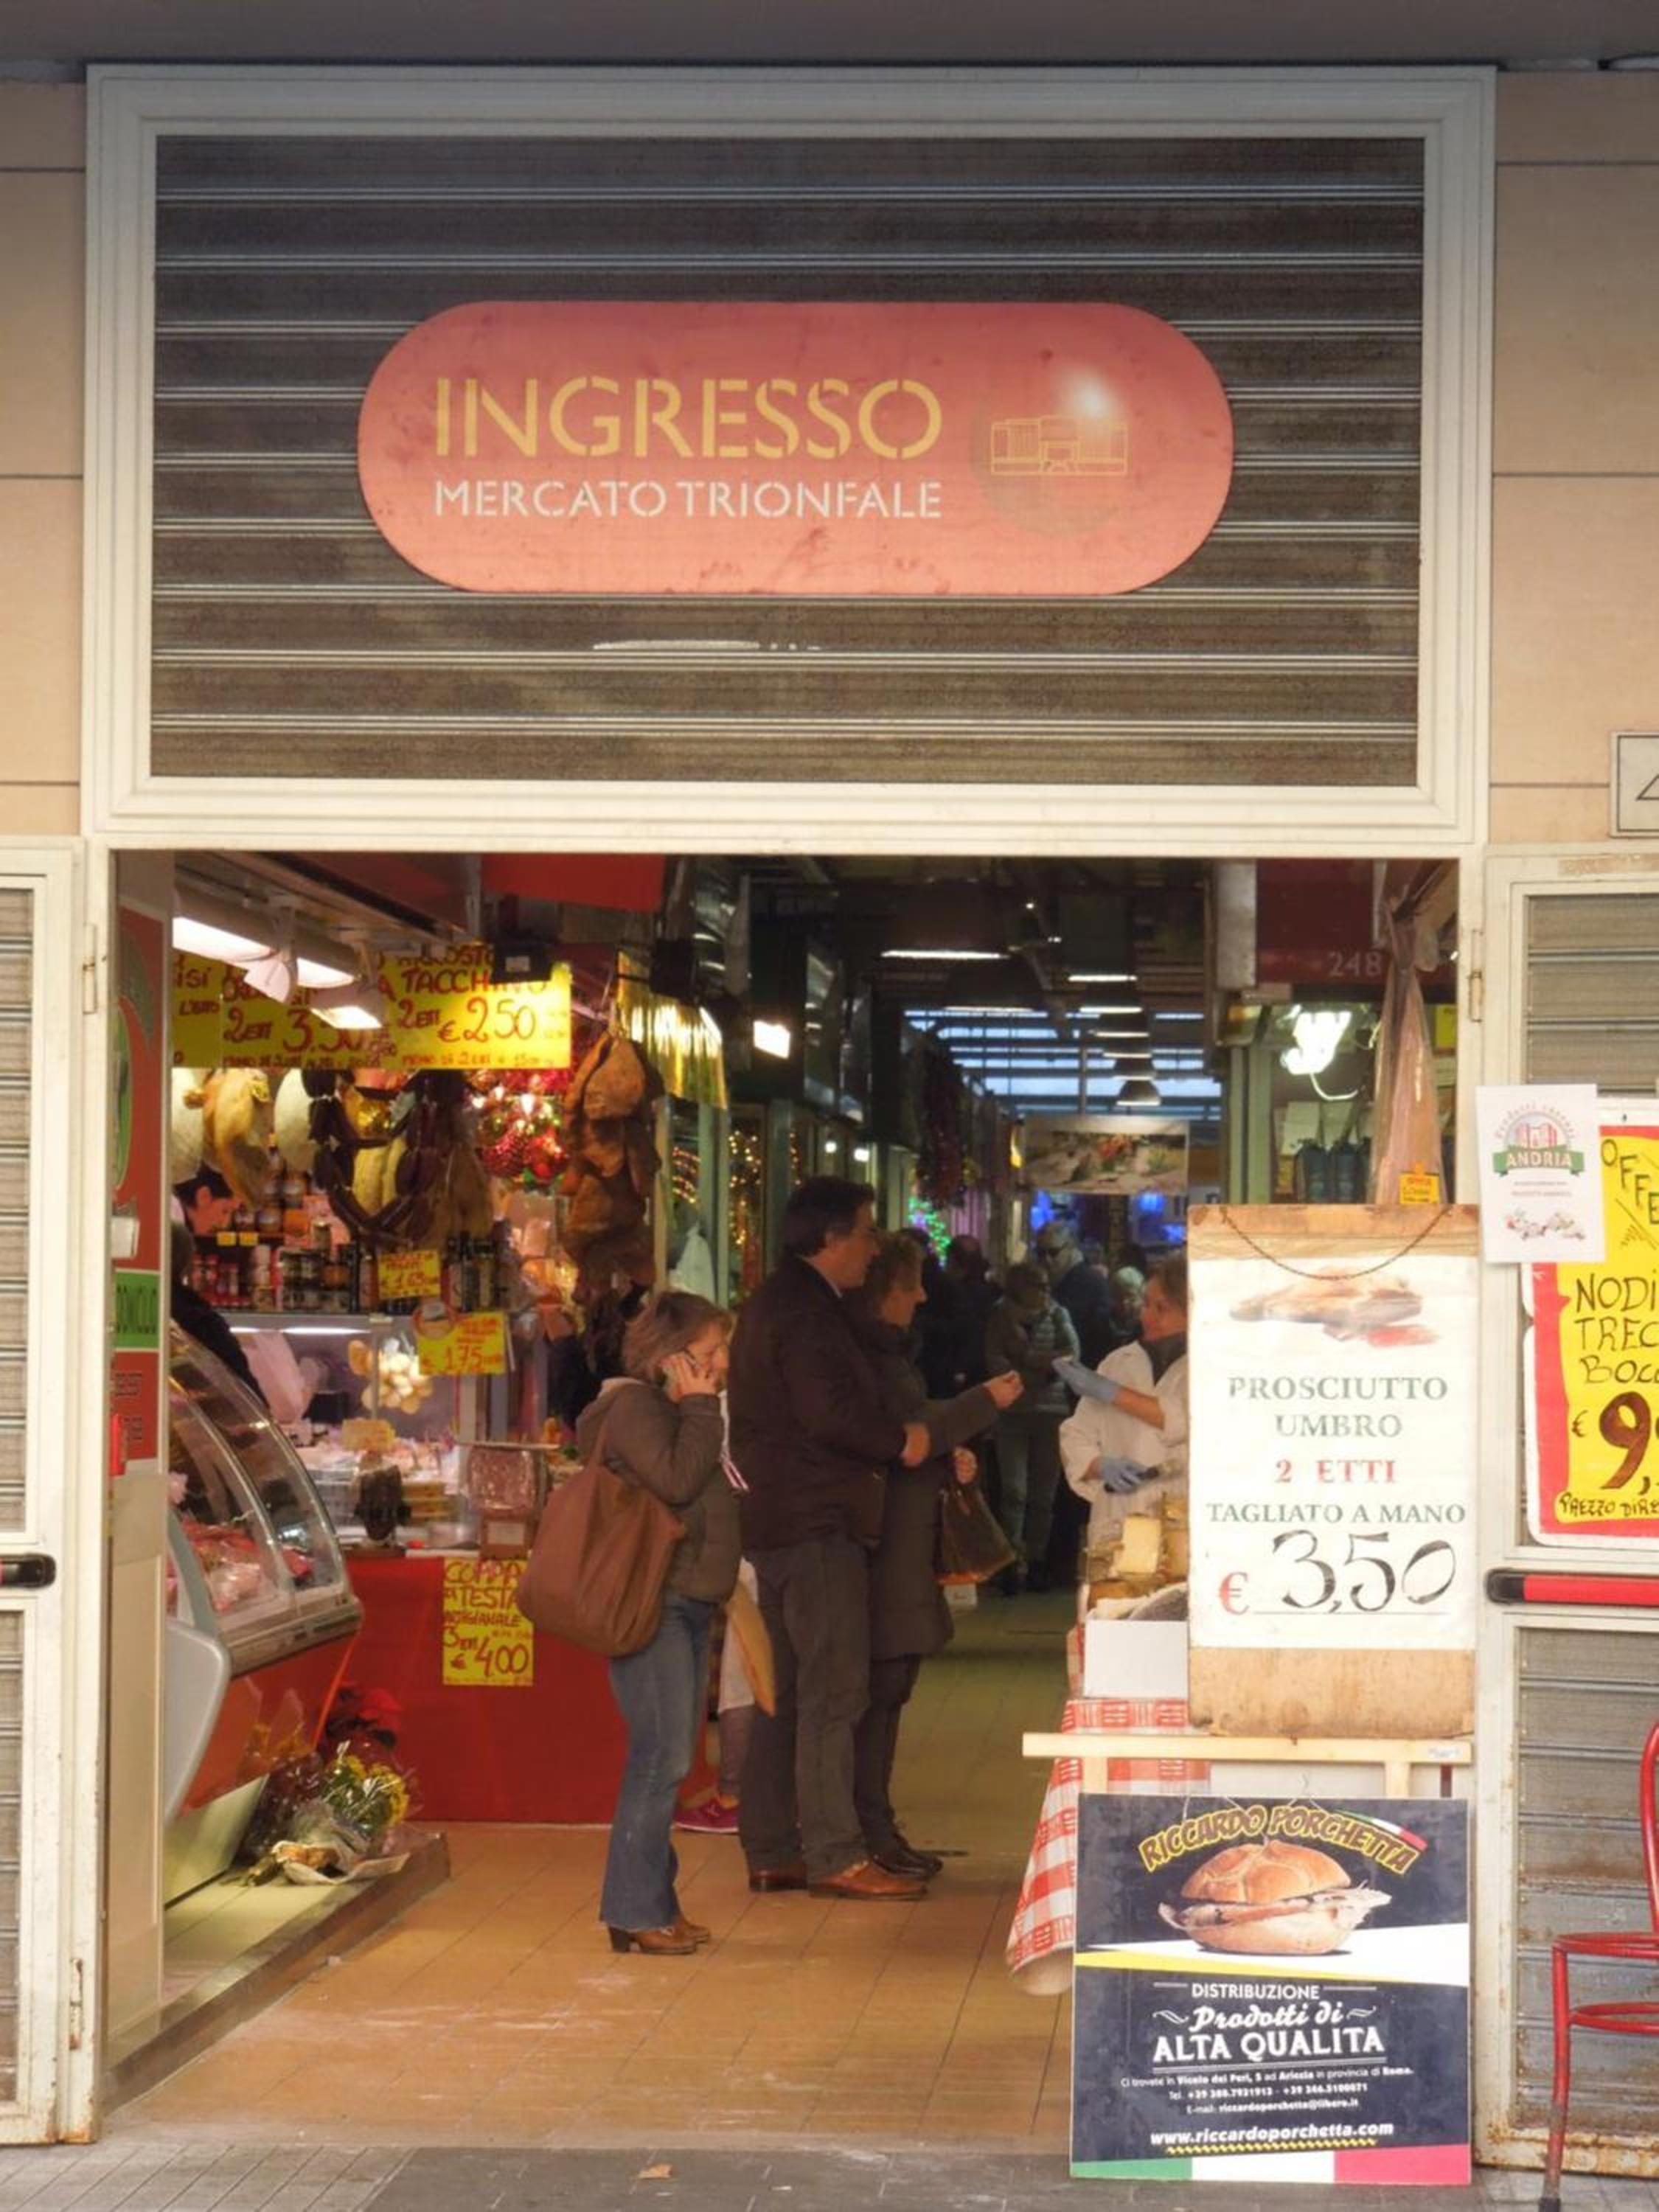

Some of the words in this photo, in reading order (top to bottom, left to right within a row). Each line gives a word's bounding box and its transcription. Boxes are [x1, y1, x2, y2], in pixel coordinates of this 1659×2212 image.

[437, 376, 942, 459] INGRESSO
[435, 480, 667, 518] MERCATO
[675, 481, 942, 518] TRIONFALE
[1329, 951, 1381, 977] 248
[1506, 1151, 1573, 1168] ANDRIA
[1228, 1376, 1447, 1399] PROSCIUTTO
[1275, 1413, 1402, 1437] UMBRO
[1571, 1409, 1589, 1439] €
[1275, 1459, 1292, 1484] 2
[1315, 1459, 1397, 1484] ETTI
[1206, 1503, 1343, 1523] TAGLIATO
[1352, 1503, 1371, 1523] A
[1379, 1504, 1466, 1523] MANO
[1217, 1571, 1249, 1615] €
[1273, 1529, 1456, 1613] 3,50
[1138, 1805, 1268, 1872] RICCARDO
[1268, 1805, 1419, 1874] PORCHETTA
[1192, 1983, 1320, 2000] DISTRIBUZIONE
[1189, 2003, 1310, 2033] Prodotti
[1315, 2000, 1344, 2025] di
[1153, 2033, 1232, 2062] ALTA
[1150, 2123, 1395, 2145] www.riccardoporchetta.com
